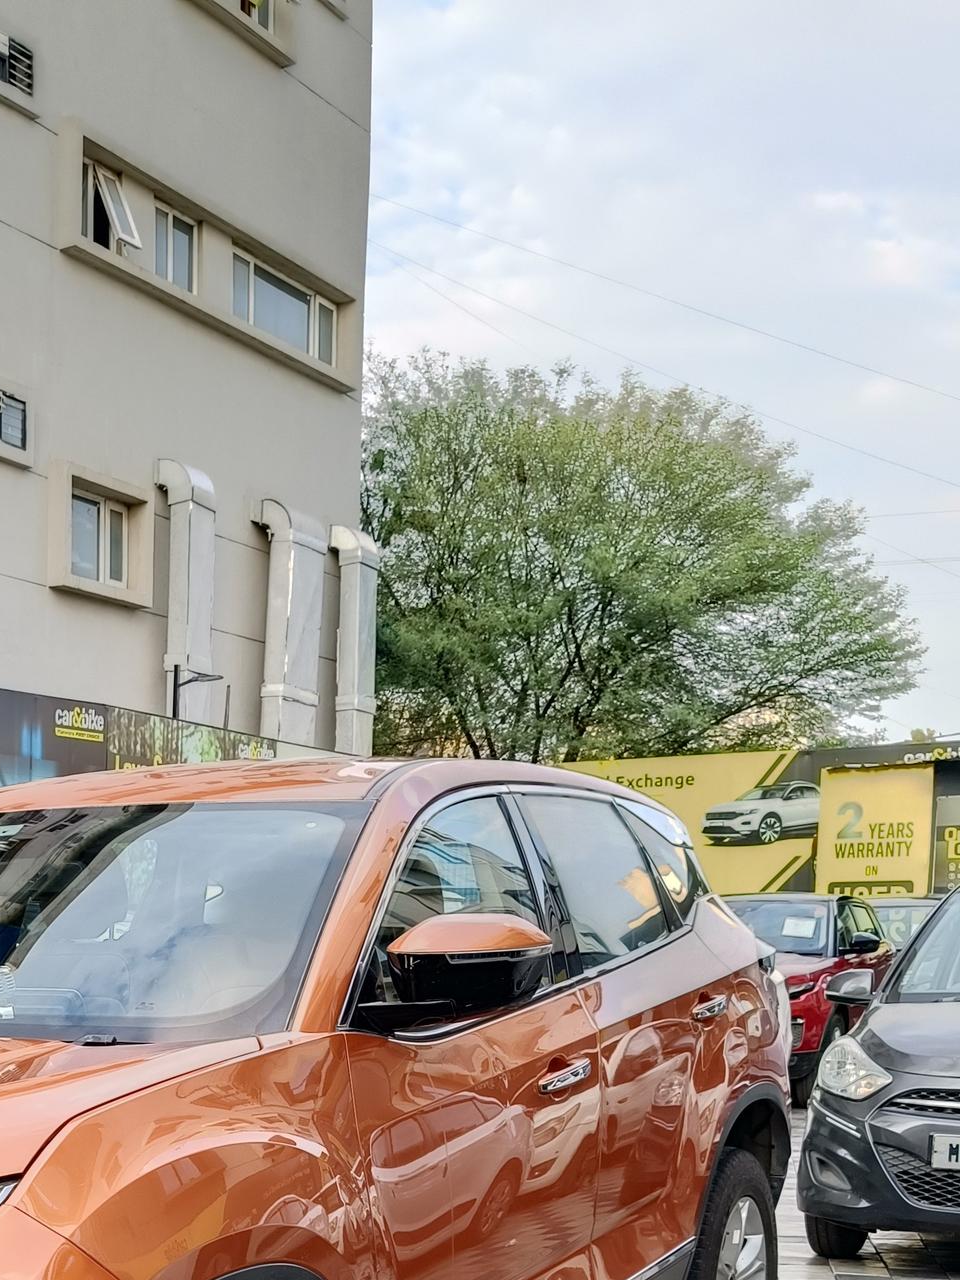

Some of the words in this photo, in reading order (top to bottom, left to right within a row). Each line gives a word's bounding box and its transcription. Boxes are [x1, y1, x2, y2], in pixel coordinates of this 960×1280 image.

[55, 706, 104, 731] car&bike
[836, 801, 864, 840] 2
[868, 822, 915, 839] YEARS
[834, 841, 913, 859] WARRANTY
[865, 865, 878, 876] ON
